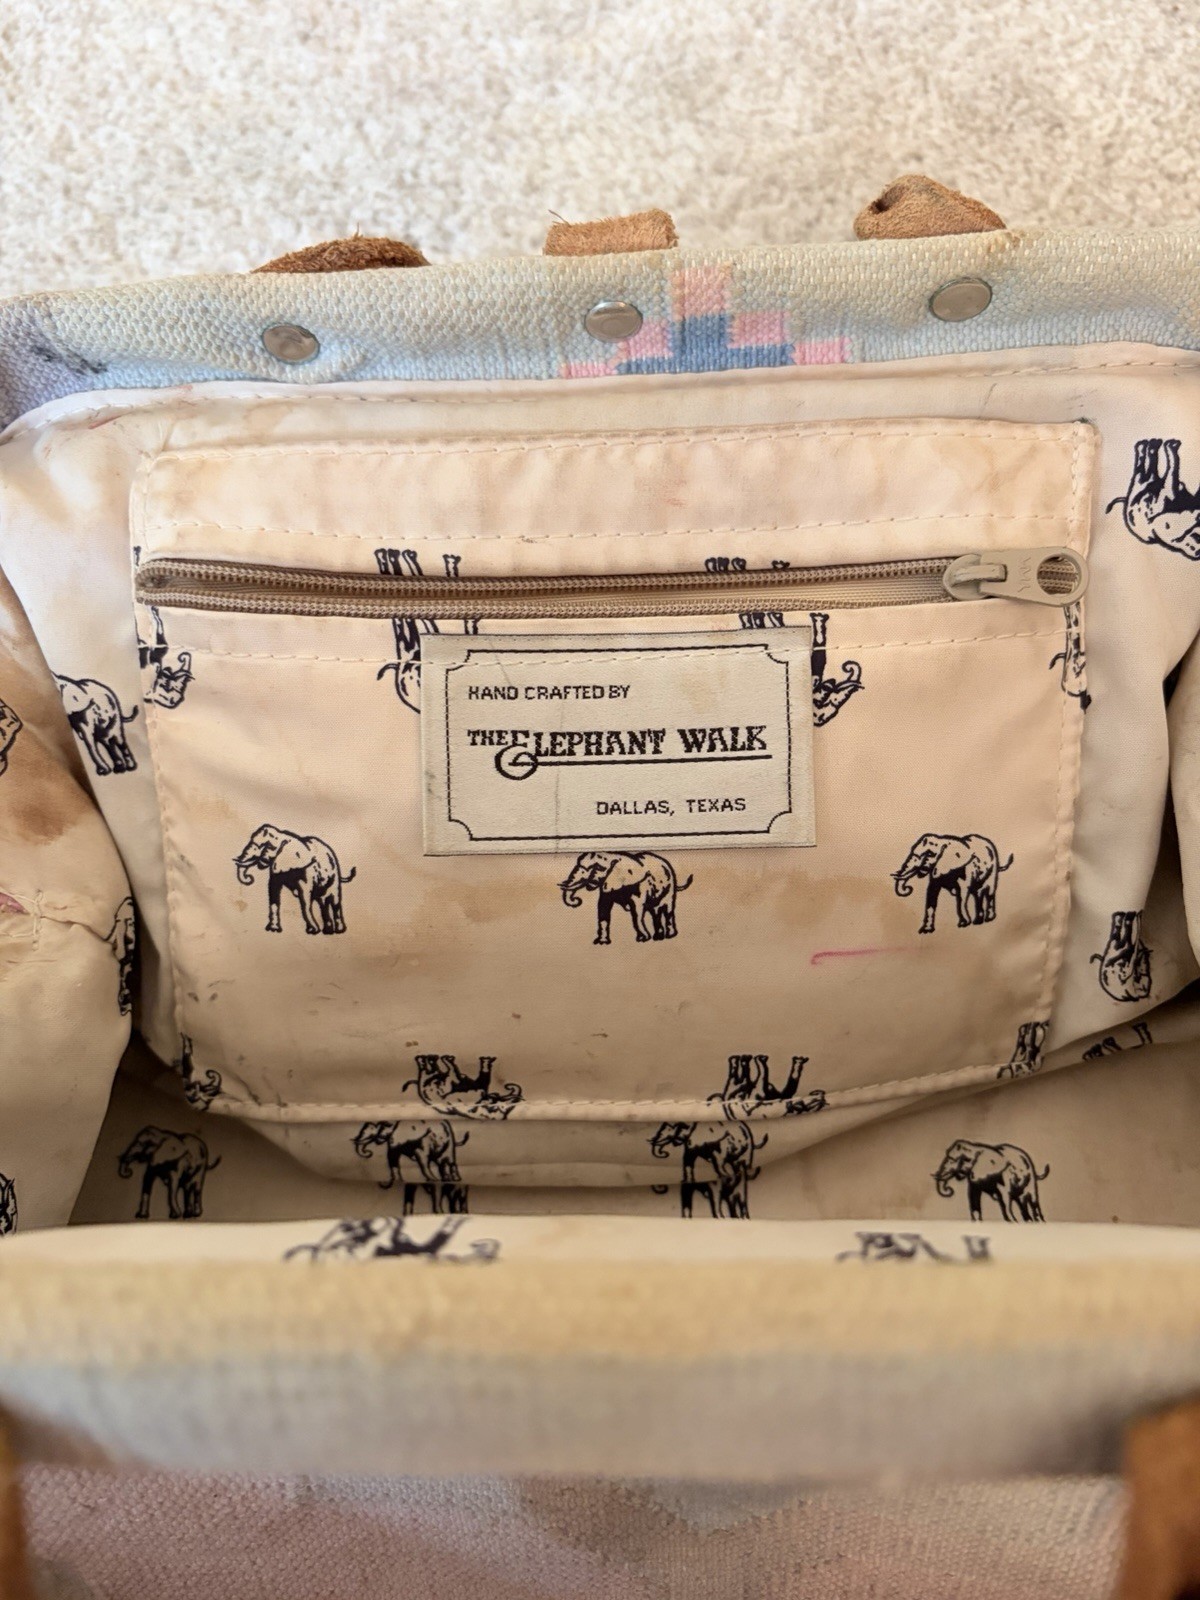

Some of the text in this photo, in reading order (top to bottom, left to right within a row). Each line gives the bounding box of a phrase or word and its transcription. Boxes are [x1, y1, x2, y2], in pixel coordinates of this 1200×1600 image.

[468, 684, 631, 701] HAND CRAFTED BY
[467, 726, 768, 780] THE ELEPHANT WALK
[596, 798, 747, 816] DALLAS, TEXAS
